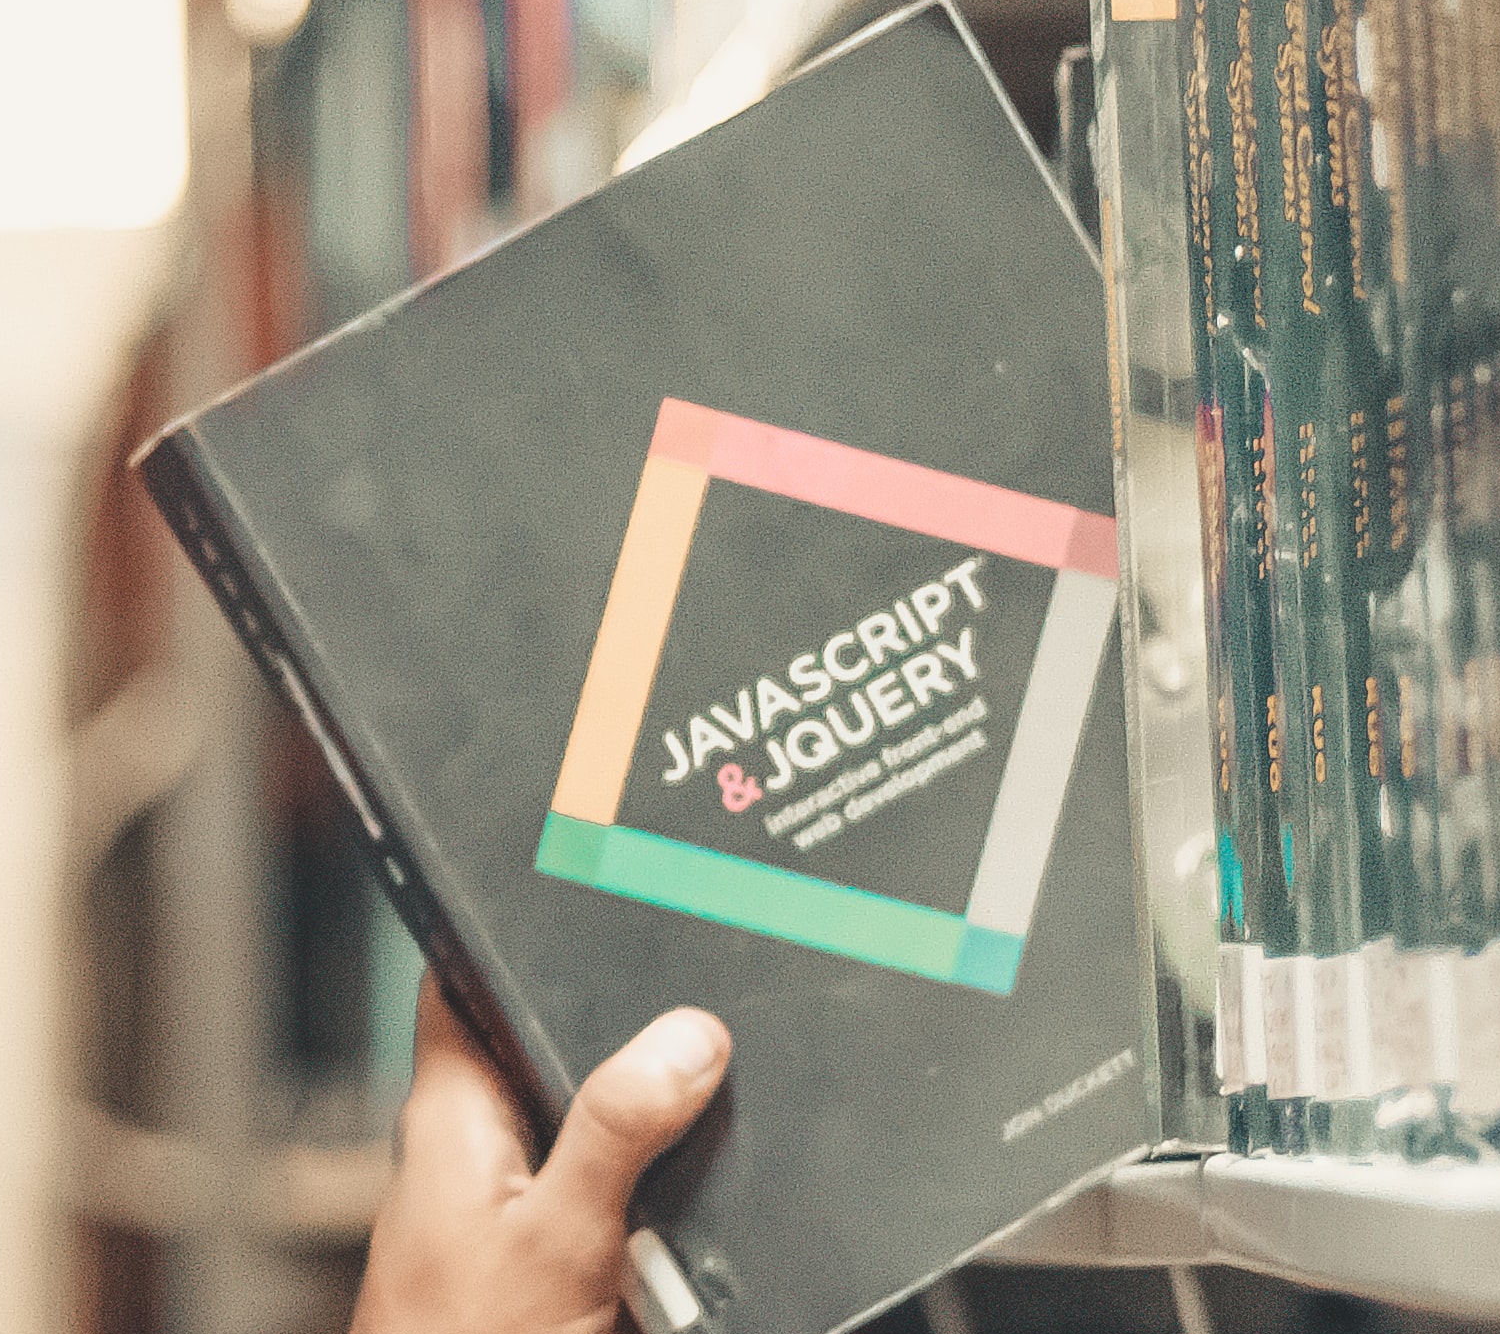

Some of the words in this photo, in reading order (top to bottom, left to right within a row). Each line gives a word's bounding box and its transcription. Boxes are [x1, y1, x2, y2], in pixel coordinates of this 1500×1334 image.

[662, 559, 984, 783] JAVASCRIPT
[717, 763, 763, 813] &
[766, 627, 978, 792] JQUERY
[793, 812, 841, 850] web
[844, 729, 987, 821] development
